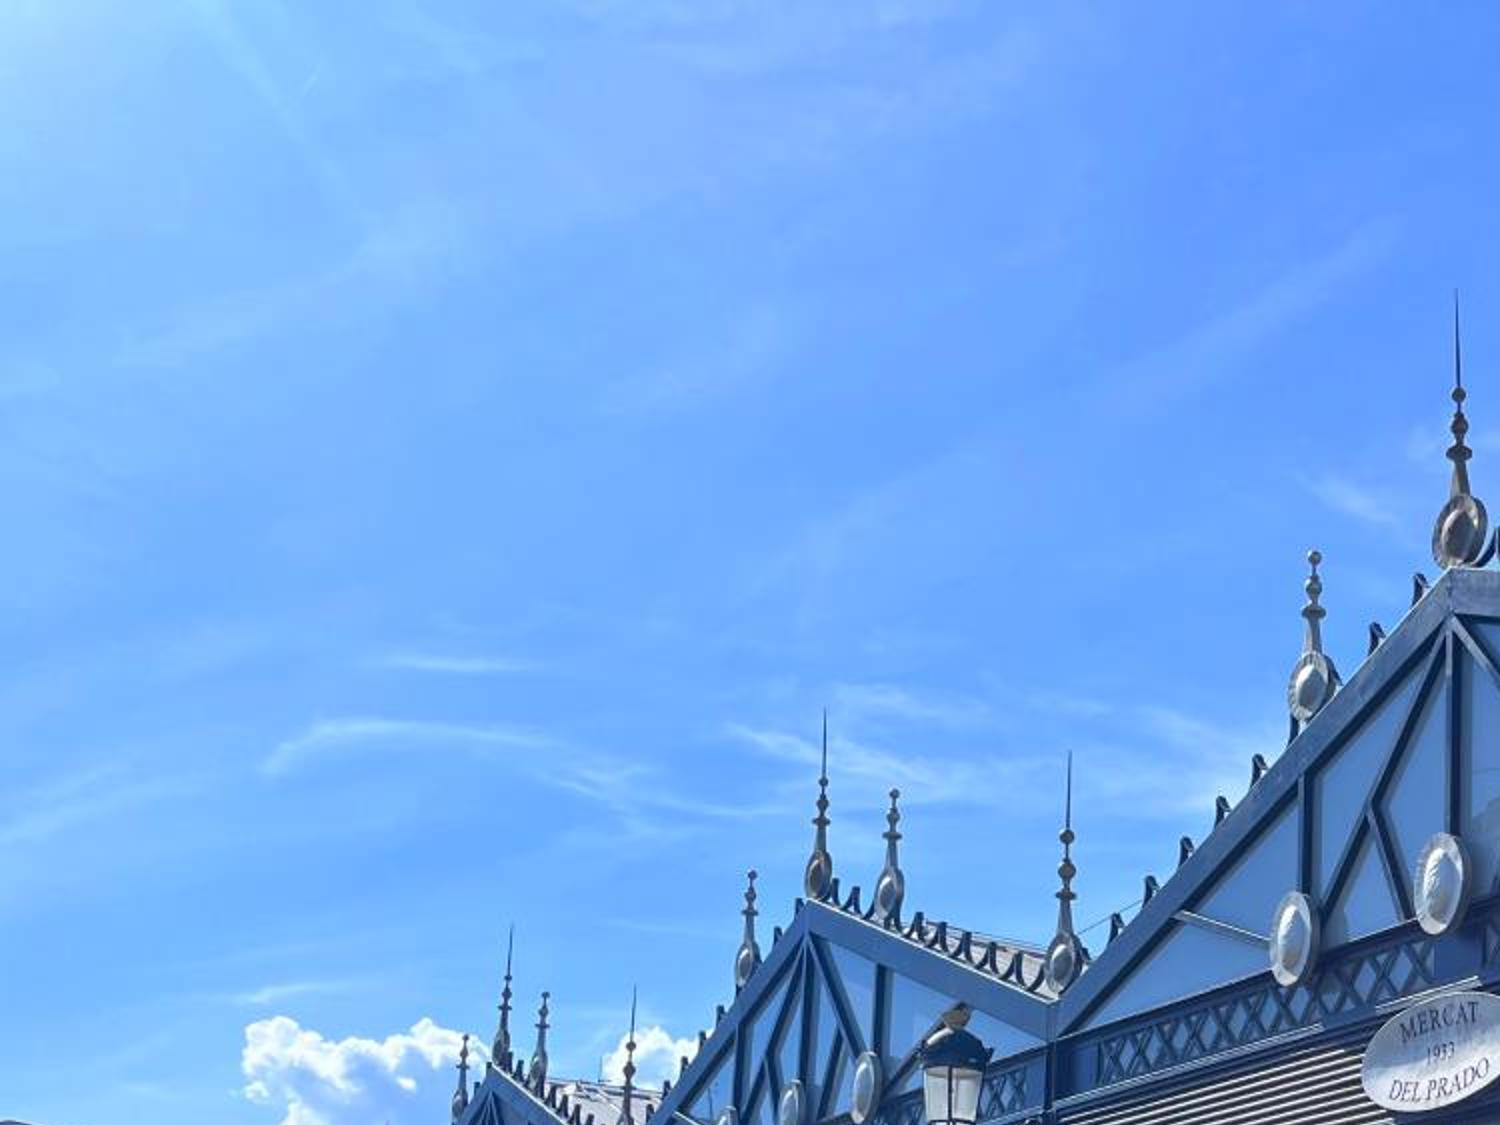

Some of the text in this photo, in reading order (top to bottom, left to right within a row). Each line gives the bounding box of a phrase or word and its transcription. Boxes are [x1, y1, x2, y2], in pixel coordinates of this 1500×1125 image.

[1399, 1001, 1479, 1042] MERCAT
[1389, 1057, 1490, 1102] DEL PRADO
